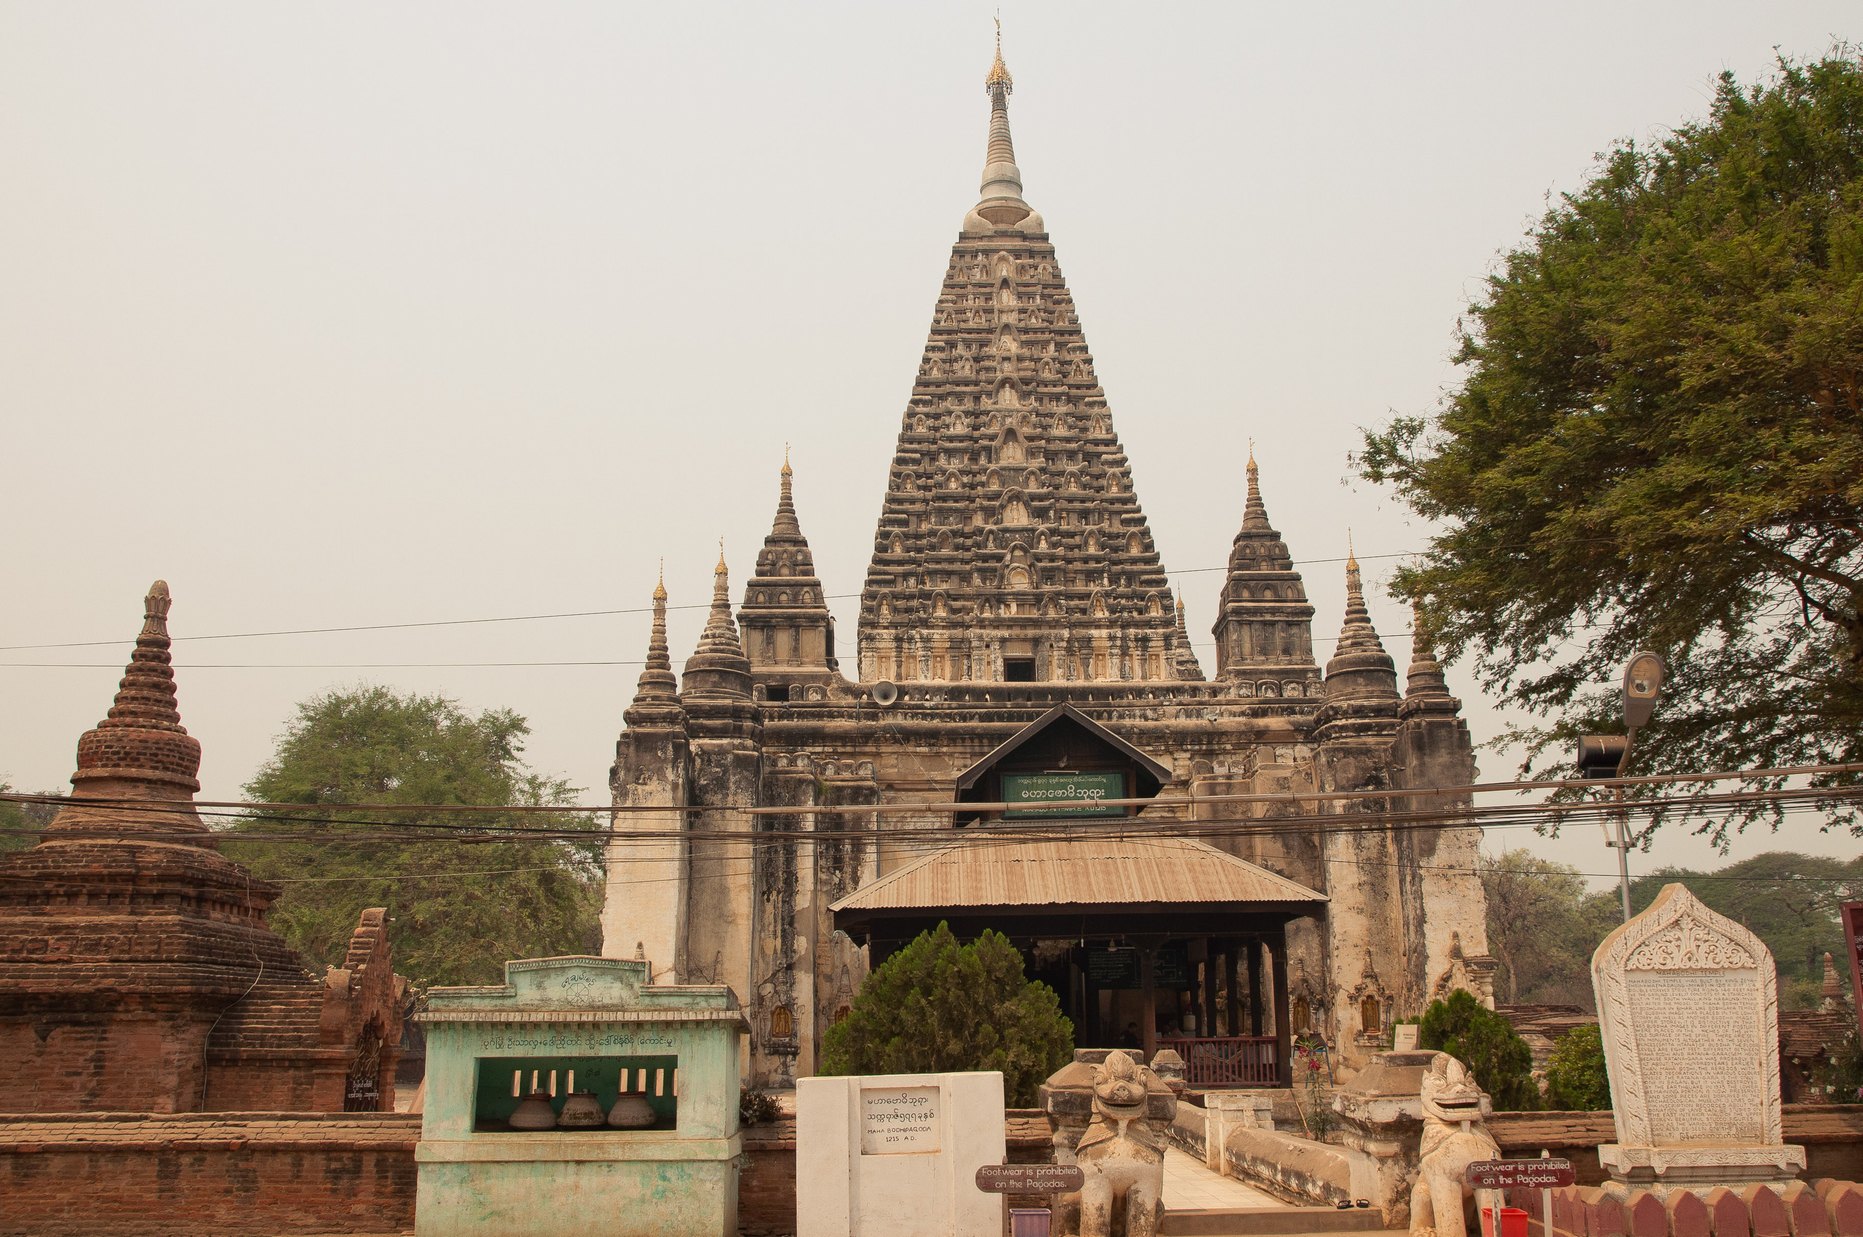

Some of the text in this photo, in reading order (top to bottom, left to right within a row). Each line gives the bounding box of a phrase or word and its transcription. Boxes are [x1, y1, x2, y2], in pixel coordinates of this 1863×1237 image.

[1026, 1166, 1034, 1176] is
[1036, 1166, 1078, 1178] prohibited
[1518, 1162, 1525, 1171] is
[1528, 1160, 1570, 1174] prohibited
[994, 1178, 1068, 1192] on the Pagodas.
[1482, 1174, 1558, 1187] on the Pagodas.
